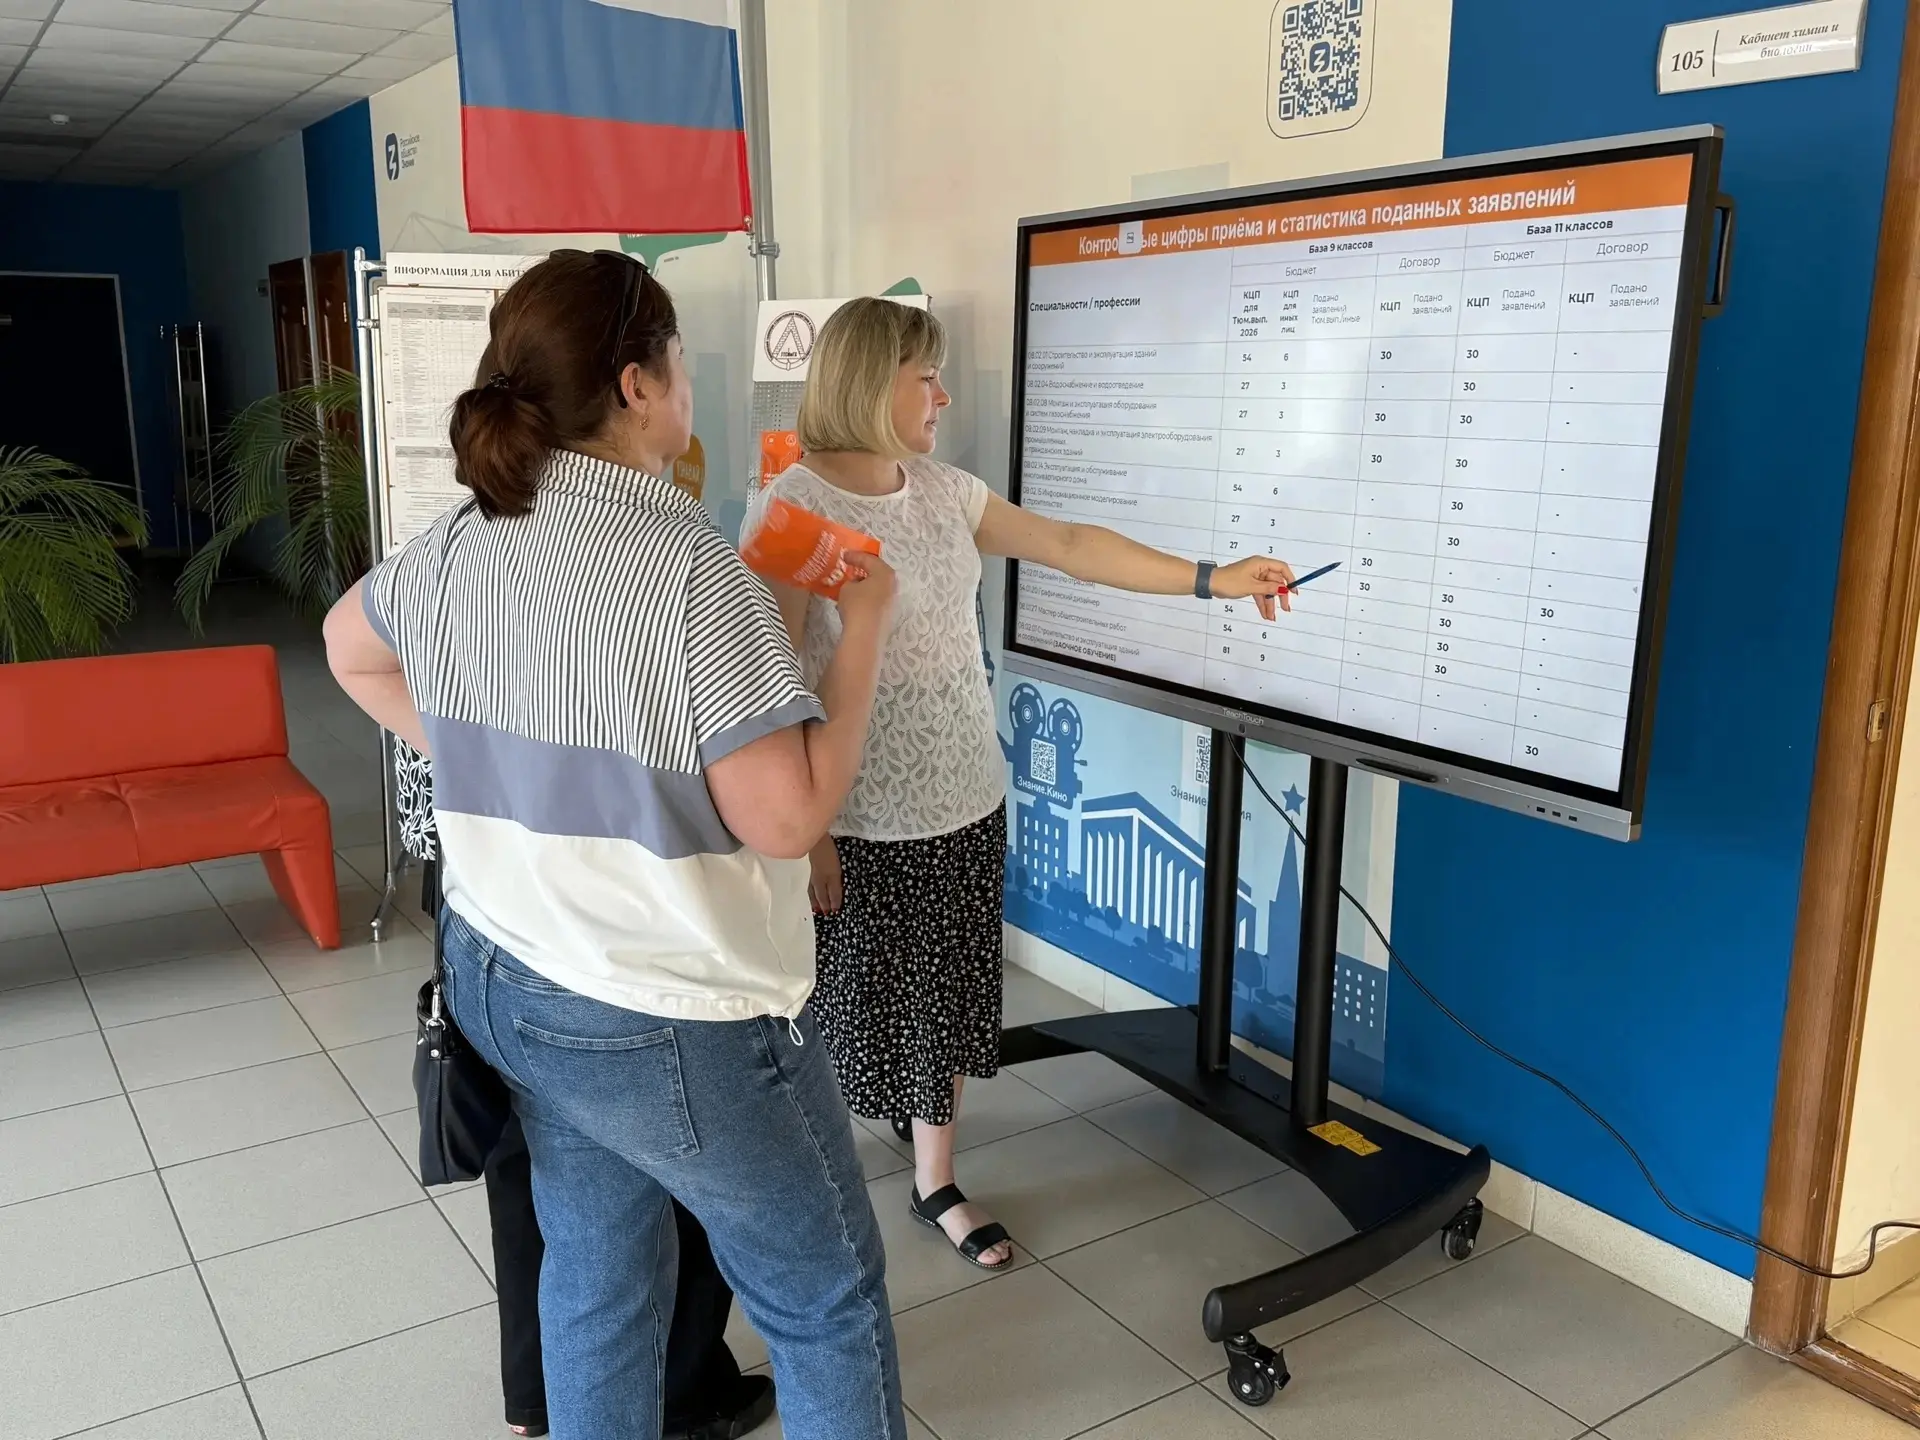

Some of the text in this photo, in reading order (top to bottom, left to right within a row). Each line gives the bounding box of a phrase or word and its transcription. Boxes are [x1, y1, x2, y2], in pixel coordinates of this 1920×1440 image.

[1739, 23, 1839, 46] Кабинет химии и
[1671, 50, 1704, 73] 105
[1162, 225, 1208, 249] цифры
[1212, 218, 1262, 246] приёма
[1267, 218, 1276, 235] и
[1281, 207, 1366, 233] статистика
[1372, 197, 1461, 225] поданных
[1467, 180, 1576, 215] заявлений
[1526, 220, 1614, 235] База 11 классов
[1309, 240, 1373, 254] База 9 классов
[1597, 242, 1649, 255] Договор
[1493, 250, 1535, 262] Бюджет
[1399, 257, 1441, 269] Договор
[394, 265, 468, 277] ИНФОРМАЦИЯ
[471, 268, 491, 278] ДЛЯ
[1285, 265, 1317, 277] Бюджет
[1610, 284, 1648, 294] Подано
[1243, 291, 1261, 300] КЦП
[1283, 290, 1299, 299] КЦП
[1313, 294, 1339, 303] Подано
[1413, 294, 1443, 303] Подано
[1502, 289, 1536, 300] Подано
[1568, 292, 1595, 304] КЦП
[1030, 300, 1088, 312] Специальности
[1094, 296, 1141, 310] профессии
[1466, 297, 1490, 308] КЦП
[1609, 296, 1660, 307] заявлений
[1243, 304, 1258, 313] для
[1283, 302, 1297, 311] для
[1380, 301, 1401, 312] КЦП
[1412, 304, 1452, 315] заявлений
[1501, 301, 1546, 312] заявлений
[1279, 314, 1298, 322] иных
[1240, 328, 1258, 337] 2026
[1281, 326, 1296, 335] лиц
[1242, 353, 1252, 362] 54
[1283, 353, 1289, 361] 6
[1380, 351, 1392, 360] 30
[1466, 350, 1479, 359] 30
[1240, 382, 1250, 390] 27
[1281, 382, 1286, 390] 3
[1463, 382, 1476, 391] 30
[1238, 410, 1248, 418] 27
[1279, 411, 1284, 419] 3
[1375, 413, 1386, 422] 30
[1459, 415, 1473, 424] 30
[1236, 448, 1245, 456] 27
[1276, 450, 1281, 458] 3
[1371, 455, 1382, 463] 30
[1455, 459, 1468, 468] 30
[1233, 484, 1242, 492] 54
[1273, 487, 1278, 495] 6
[1451, 502, 1464, 511] 30
[1231, 515, 1240, 523] 27
[1270, 519, 1275, 527] 3
[1229, 541, 1238, 549] 27
[1447, 538, 1460, 547] 30
[1268, 546, 1273, 554] 3
[1361, 558, 1373, 567] 30
[1359, 582, 1371, 591] 30
[1441, 594, 1454, 604] 30
[1224, 605, 1234, 613] 54
[1540, 608, 1554, 618] 30
[1439, 618, 1452, 628] 30
[1223, 624, 1232, 633] 54
[1222, 646, 1230, 654] 81
[1436, 642, 1449, 652] 30
[1260, 654, 1265, 662] 9
[1434, 665, 1447, 675] 30
[1222, 707, 1264, 726] TeachTouch
[1525, 746, 1539, 756] 30
[1017, 776, 1068, 803] Знание.Кино
